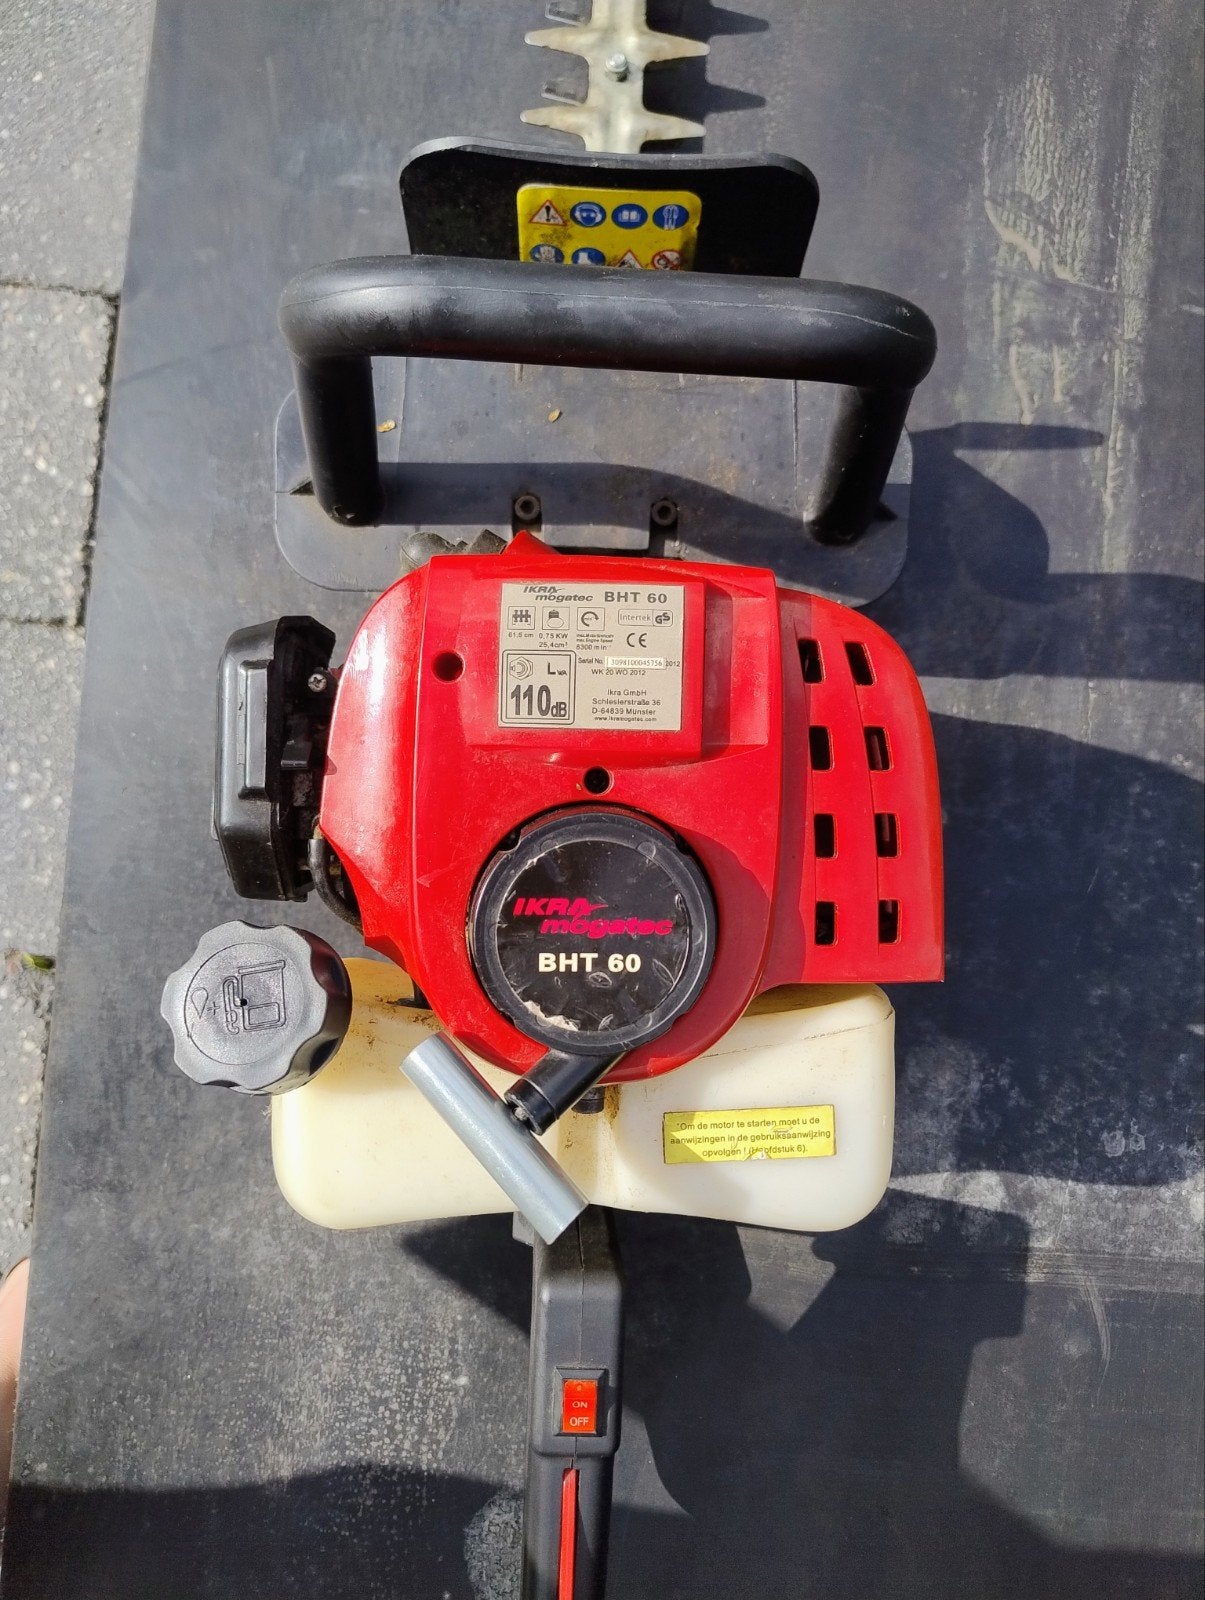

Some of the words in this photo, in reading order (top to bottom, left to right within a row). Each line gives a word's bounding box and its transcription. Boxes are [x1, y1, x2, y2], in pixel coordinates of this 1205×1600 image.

[523, 586, 562, 594] IKRA
[604, 591, 641, 603] BHT
[647, 593, 668, 604] 60
[619, 614, 651, 622] Intertek
[623, 689, 647, 697] GmbH
[513, 897, 609, 916] IKRA
[540, 915, 674, 939] mogatec
[538, 952, 599, 973] BHT
[607, 953, 642, 973] 60
[697, 1121, 709, 1130] de
[710, 1121, 735, 1129] motor
[736, 1120, 746, 1128] te
[747, 1118, 778, 1128] starten
[778, 1117, 801, 1126] moet
[809, 1117, 821, 1125] de
[670, 1134, 727, 1146] aanwijzingen
[727, 1133, 737, 1143] in
[737, 1133, 749, 1143] de
[750, 1129, 832, 1143] gebruiksaanwijzing
[702, 1148, 743, 1158] opvolgen
[569, 1416, 590, 1427] OFF
